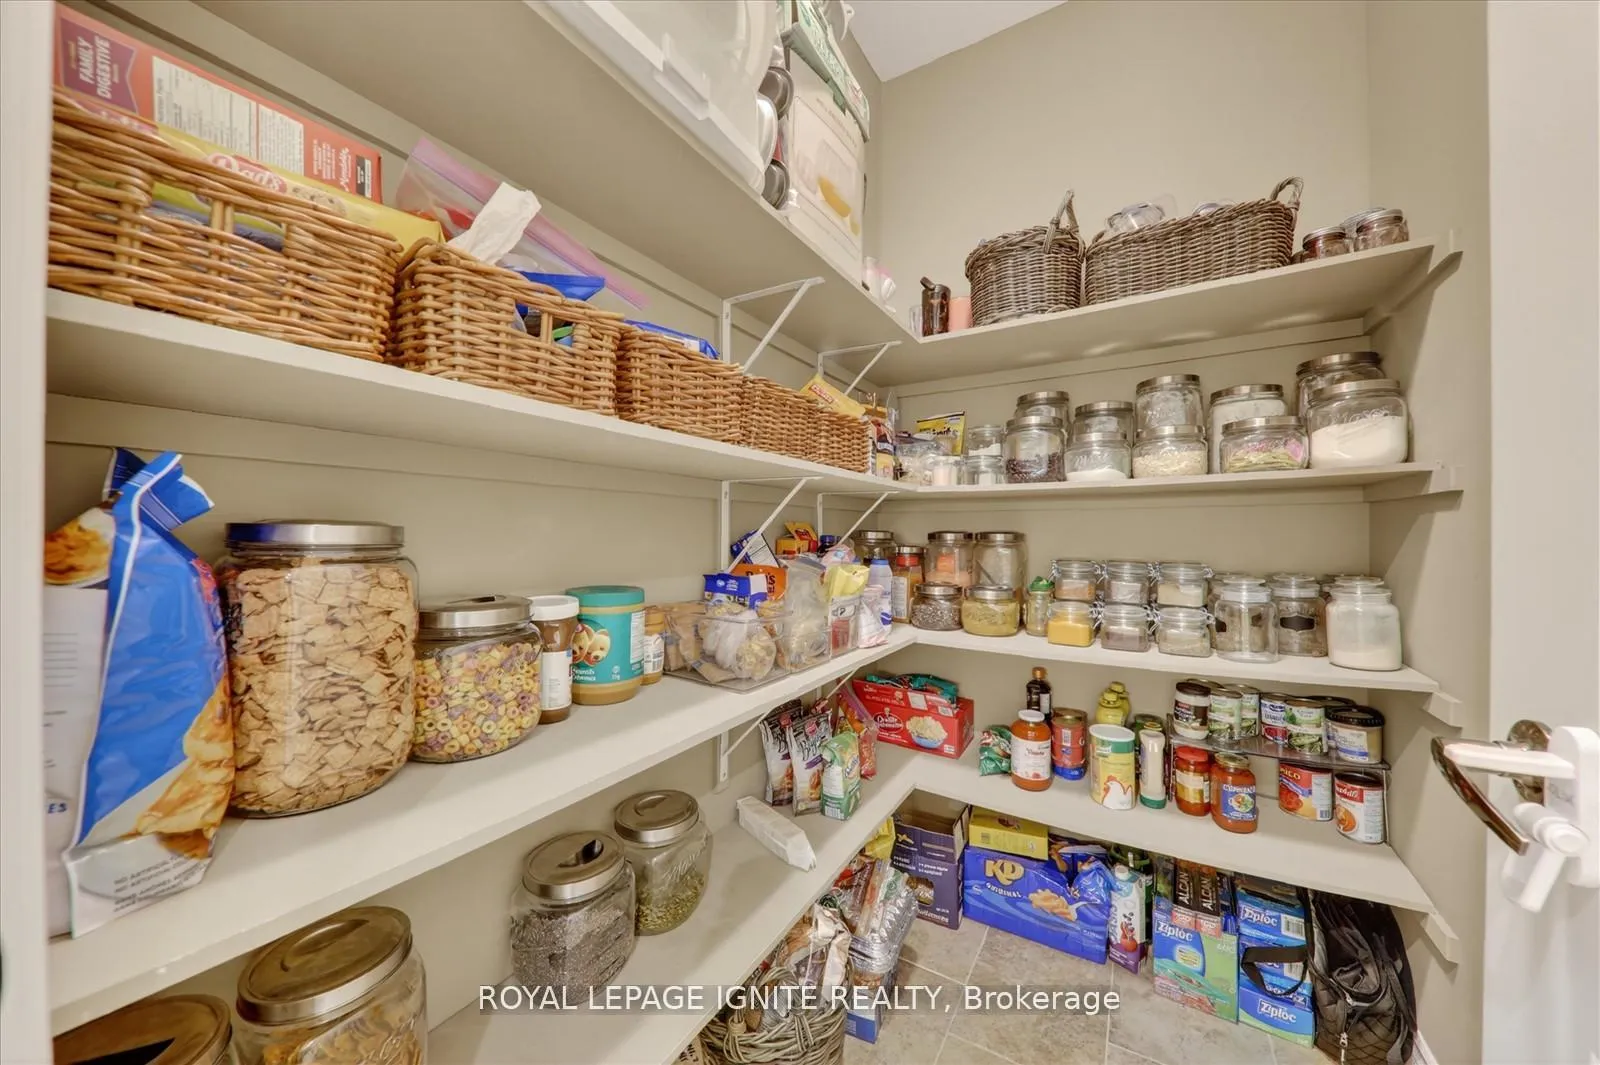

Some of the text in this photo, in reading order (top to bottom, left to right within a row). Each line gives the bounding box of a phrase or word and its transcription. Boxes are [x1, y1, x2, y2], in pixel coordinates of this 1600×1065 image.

[77, 36, 96, 84] FAMILY
[94, 36, 113, 99] DIGESTIVE
[984, 859, 1025, 886] KD
[1178, 871, 1190, 905] ALCAN
[1200, 875, 1213, 912] ALCAN
[1157, 920, 1193, 942] Ziploc
[1244, 908, 1278, 927] Ziploc
[1260, 1001, 1297, 1023] Ziploc
